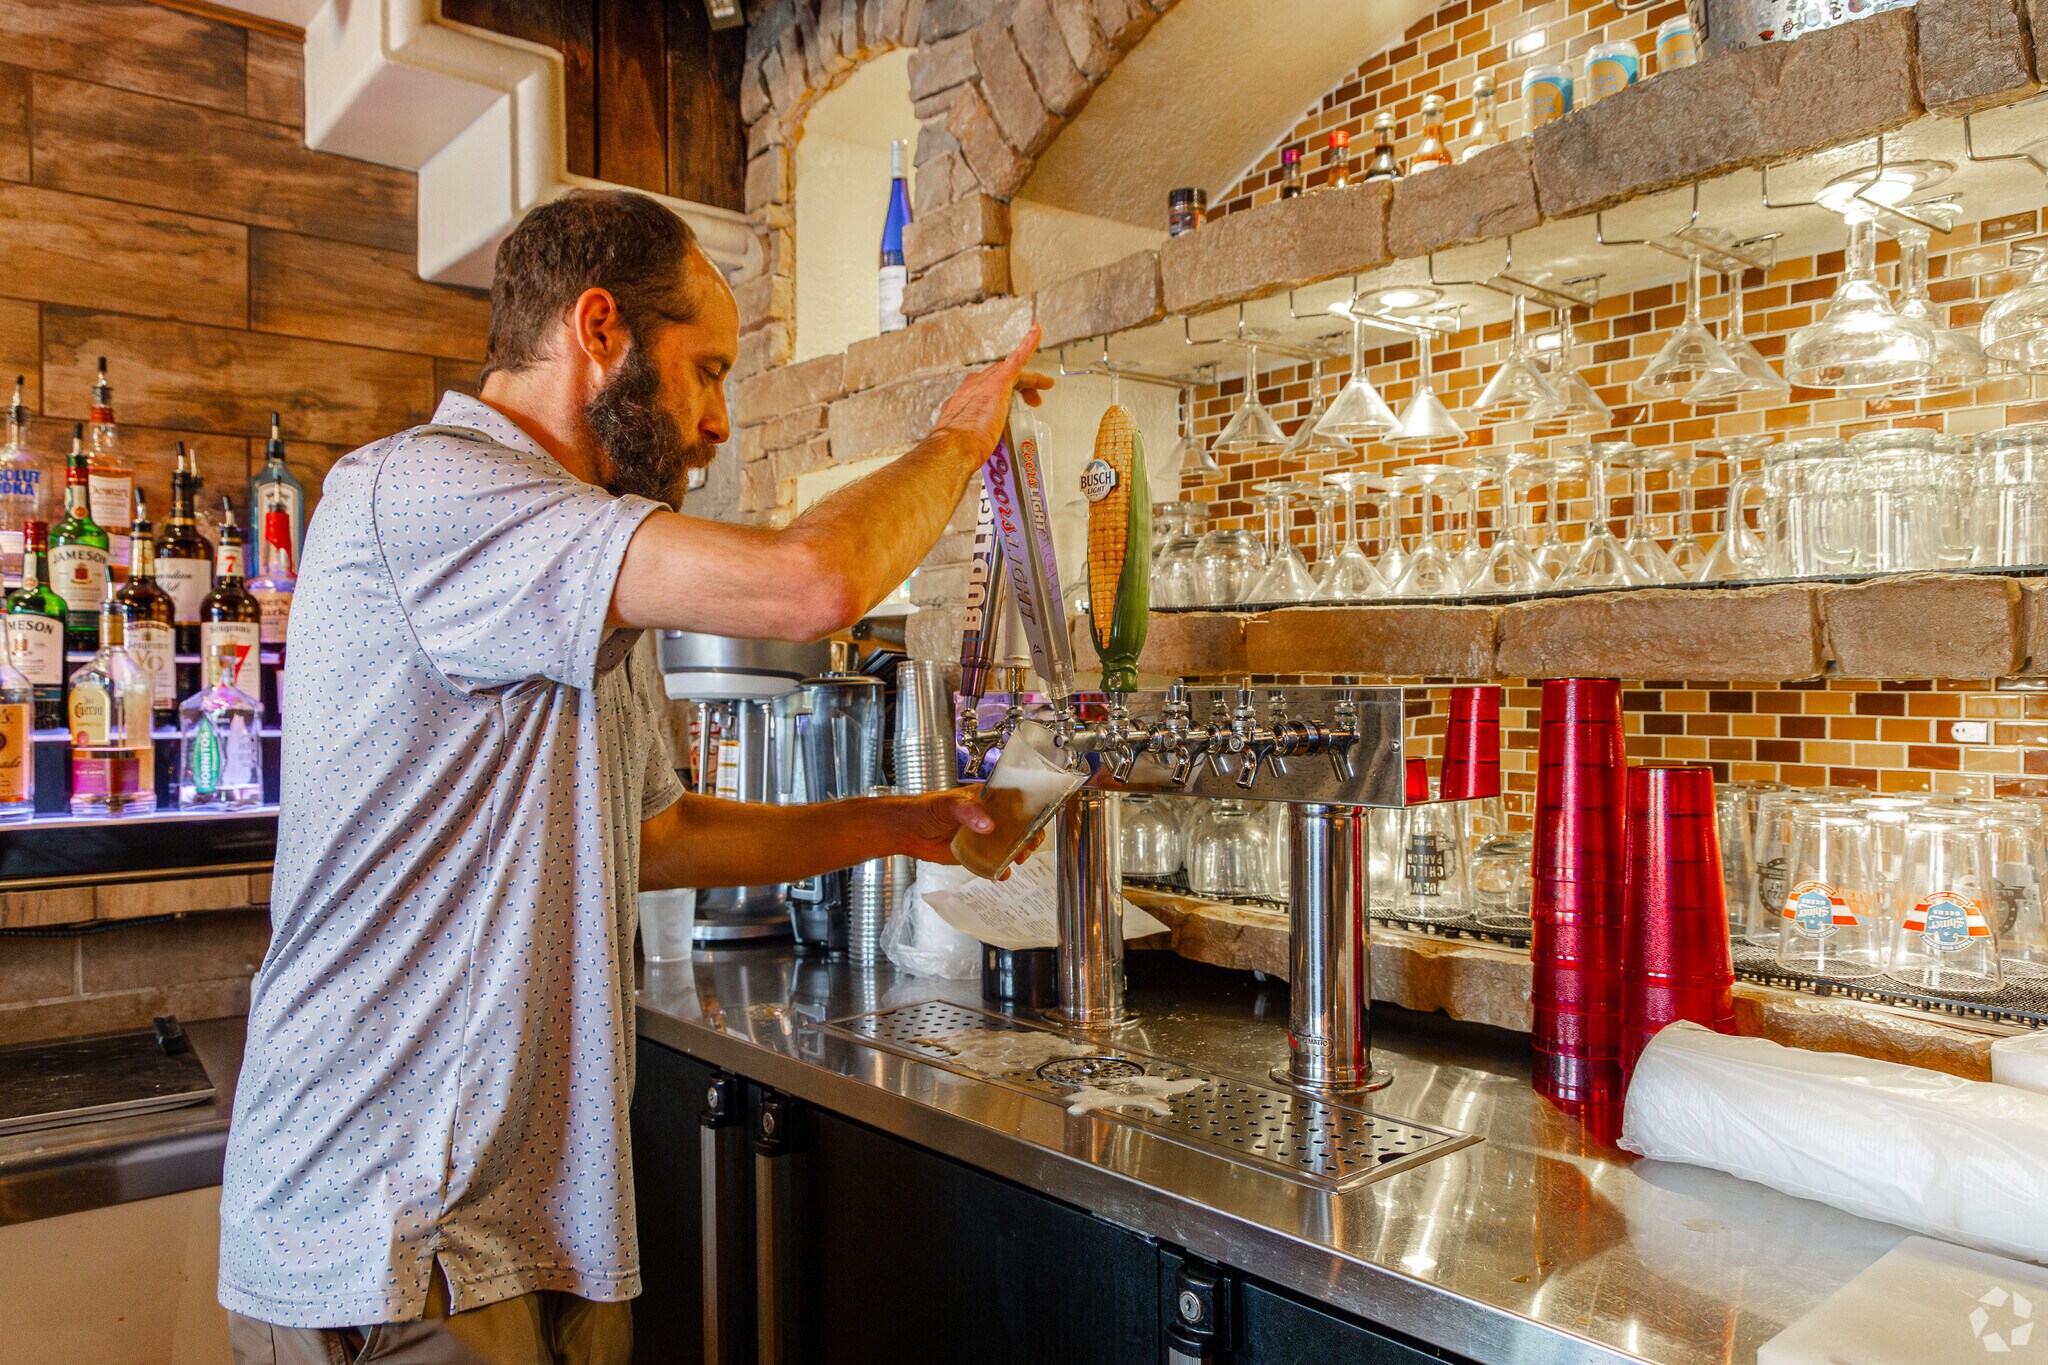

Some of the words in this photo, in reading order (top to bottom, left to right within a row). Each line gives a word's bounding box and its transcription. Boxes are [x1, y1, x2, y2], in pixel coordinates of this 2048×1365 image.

[0, 468, 40, 483] OLUT
[1080, 470, 1112, 489] BUSCH
[1021, 438, 1039, 488] Coors
[1030, 486, 1047, 534] LIGHT
[1087, 485, 1105, 495] LIGHT
[53, 550, 107, 564] JAMESON
[224, 554, 237, 573] 7
[1004, 532, 1037, 627] LIGHT
[963, 558, 989, 631] BUD
[200, 731, 212, 789] HORNITOS
[1407, 853, 1443, 865] PARLOR
[1406, 864, 1444, 878] CHILLI
[1932, 909, 1961, 917] BEERS
[1927, 916, 1966, 930] Shiner
